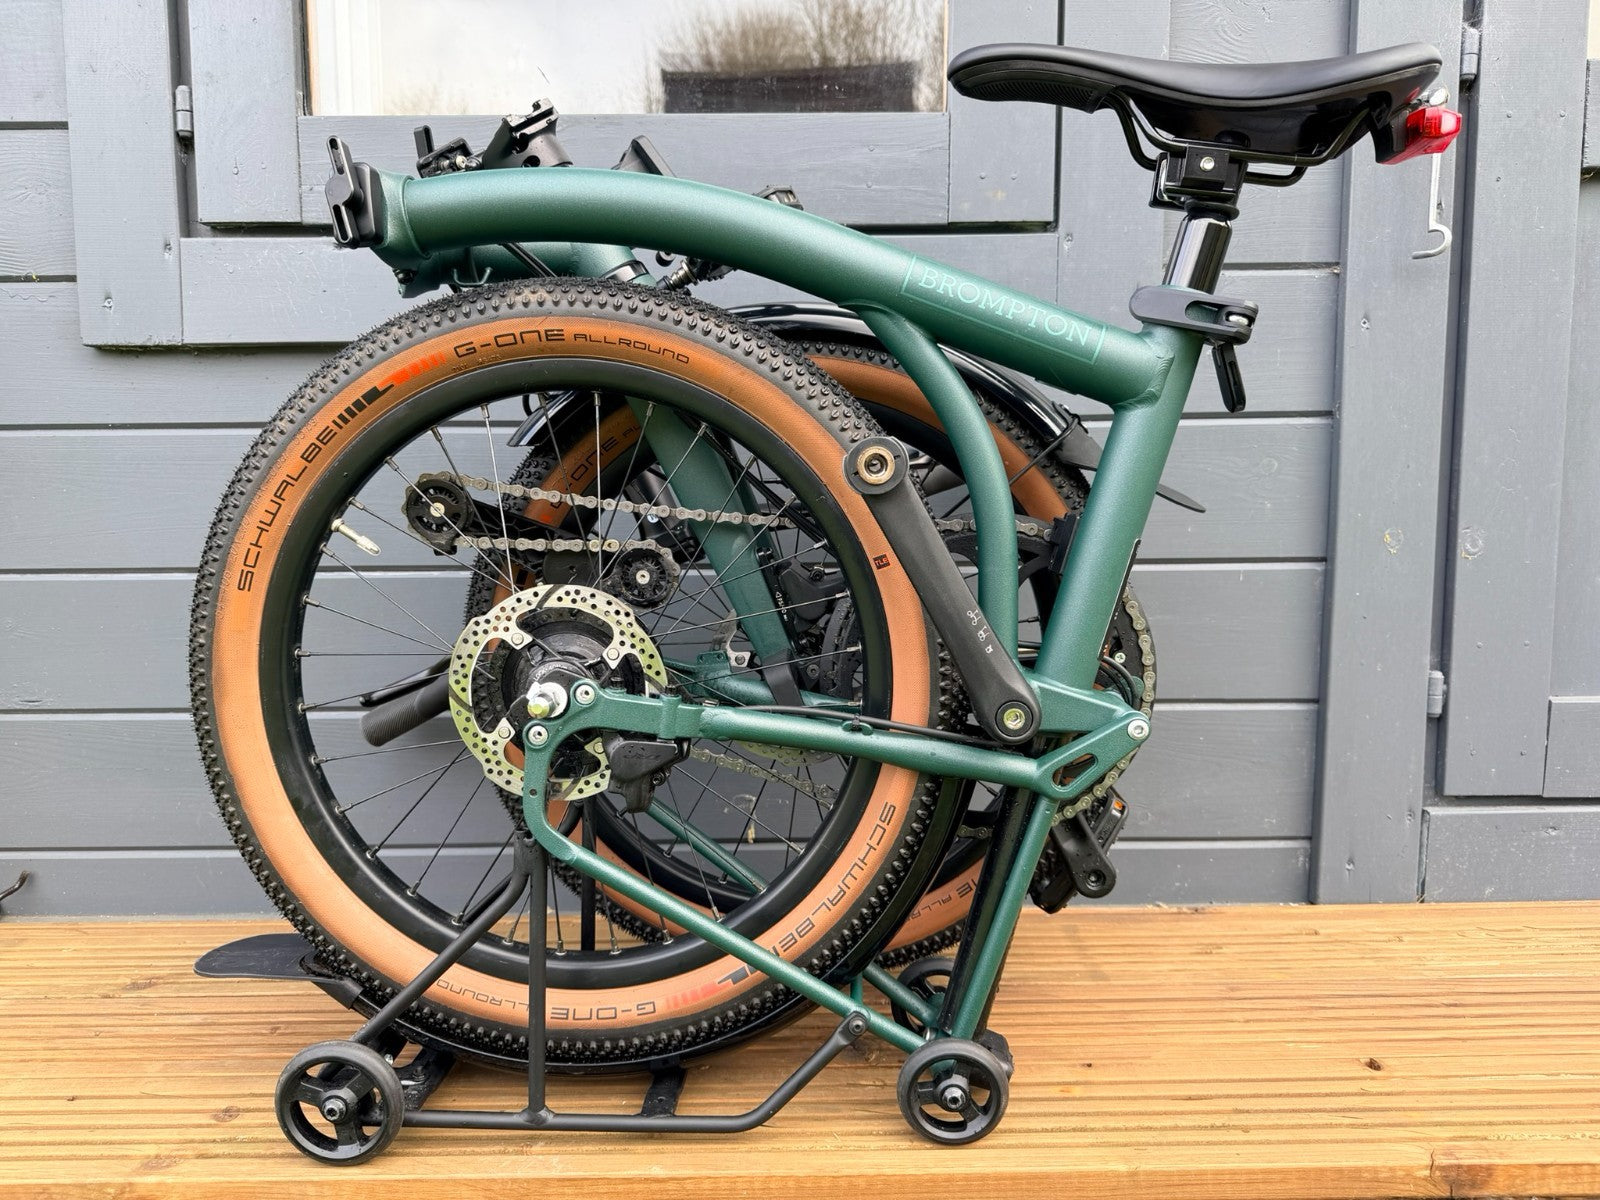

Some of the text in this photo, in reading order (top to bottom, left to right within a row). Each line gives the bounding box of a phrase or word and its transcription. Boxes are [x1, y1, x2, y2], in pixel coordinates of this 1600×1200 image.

[453, 328, 690, 364] G-ONE ALLROUND
[918, 265, 1093, 347] BROMPTON
[237, 425, 338, 593] SCHWALBE
[778, 801, 897, 953] SCHWALBE
[436, 979, 657, 1021] G-ONE LLROUND
